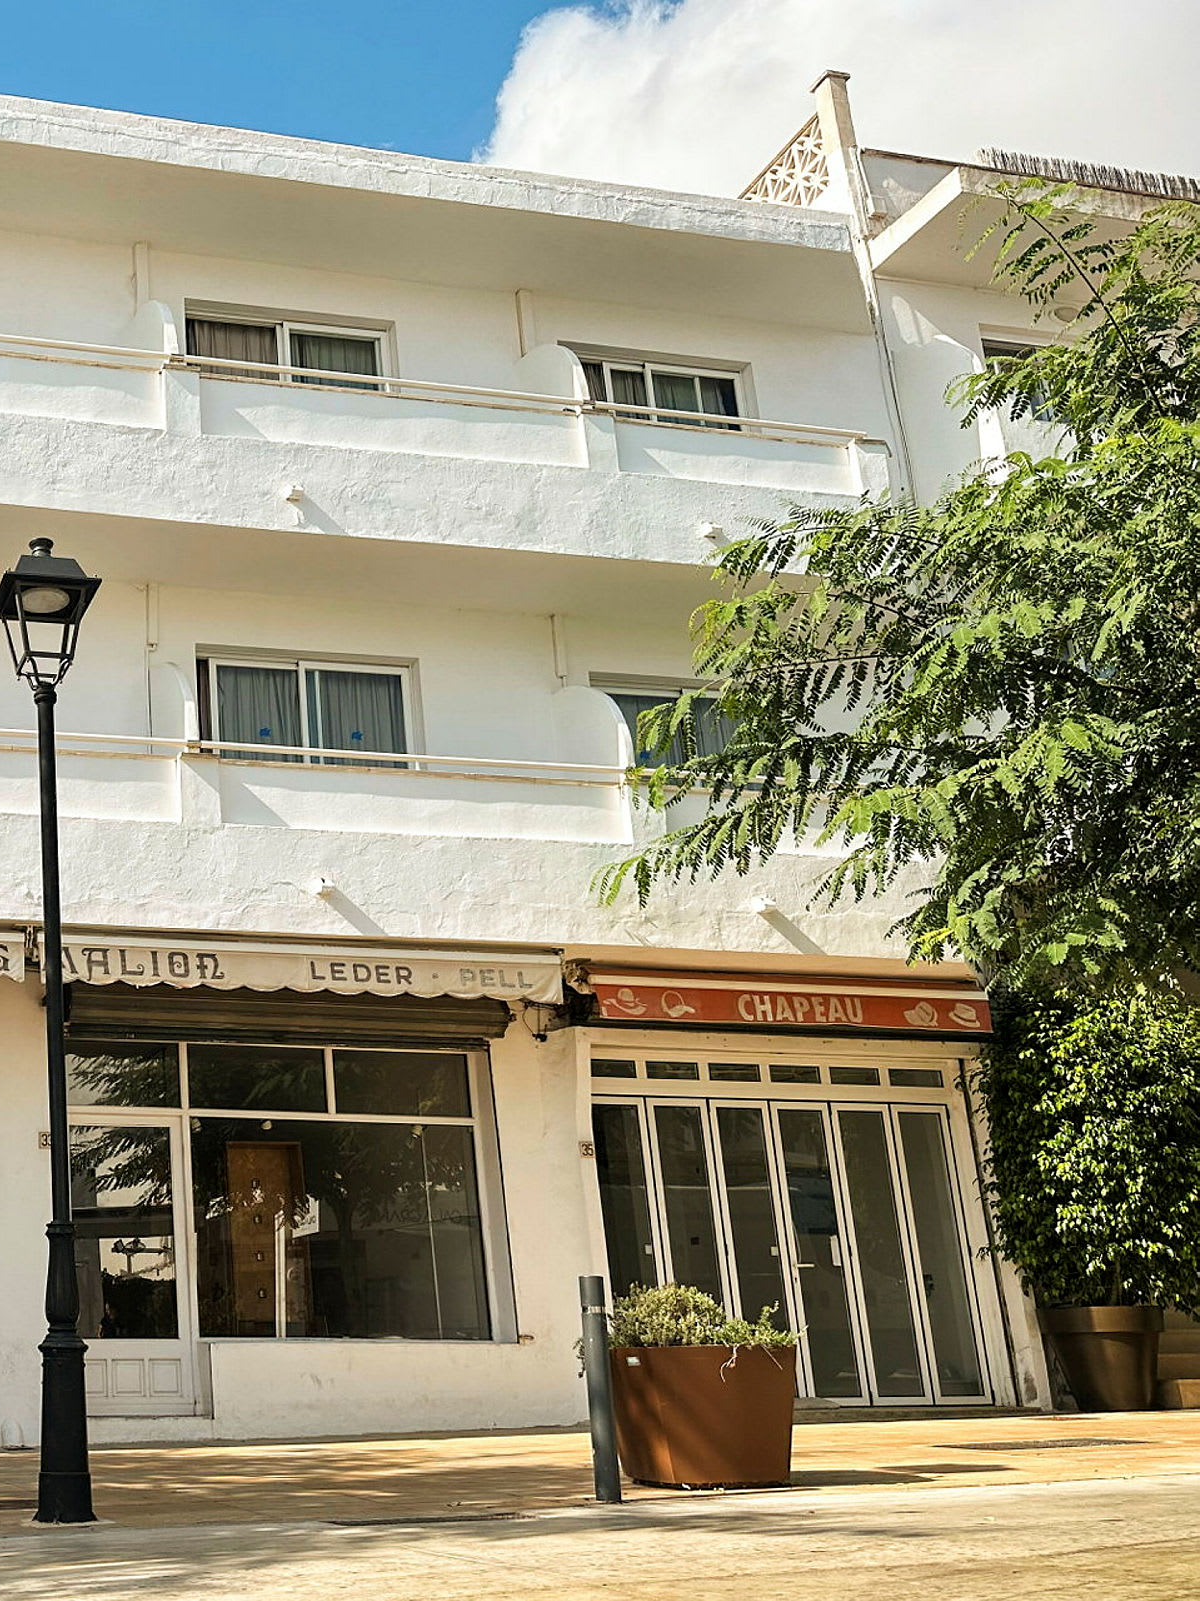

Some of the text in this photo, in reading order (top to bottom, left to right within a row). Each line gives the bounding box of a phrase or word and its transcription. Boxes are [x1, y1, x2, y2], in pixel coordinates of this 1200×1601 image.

[310, 961, 412, 985] LEDER
[459, 968, 534, 989] PELL
[737, 993, 864, 1024] CHAPEAU
[581, 1143, 594, 1157] 35
